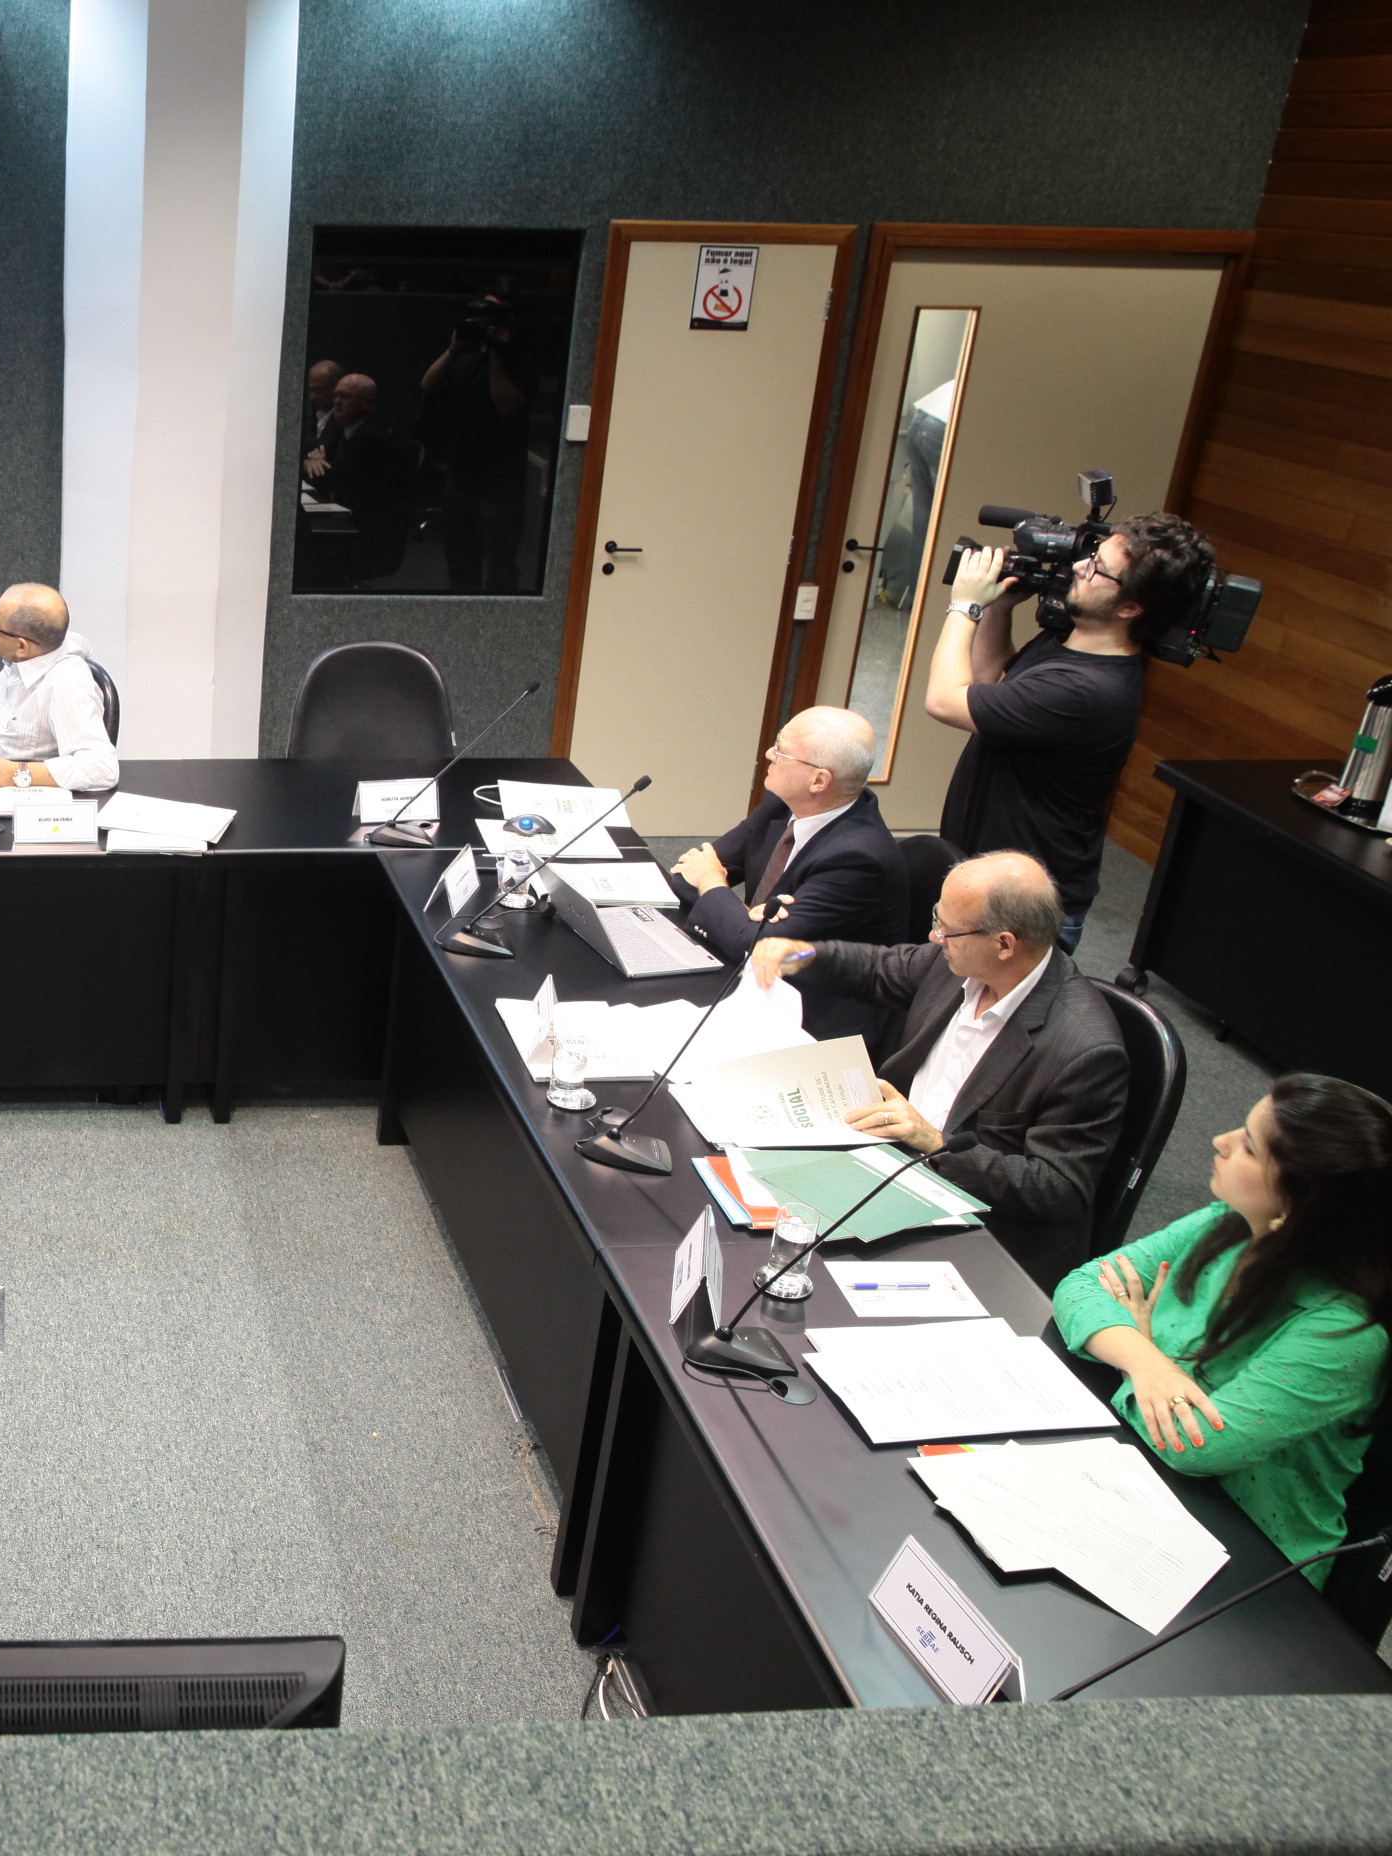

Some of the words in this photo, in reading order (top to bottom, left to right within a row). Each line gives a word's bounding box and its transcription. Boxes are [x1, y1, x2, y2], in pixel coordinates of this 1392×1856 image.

[706, 249, 733, 257] Fumar
[730, 257, 752, 265] legal
[814, 1077, 823, 1086] DE
[787, 1087, 814, 1129] SOCIAL
[905, 1582, 924, 1607] KATIA
[923, 1603, 947, 1634] REGINA
[947, 1631, 975, 1666] RAUSCH
[915, 1625, 940, 1655] SEBRAE
